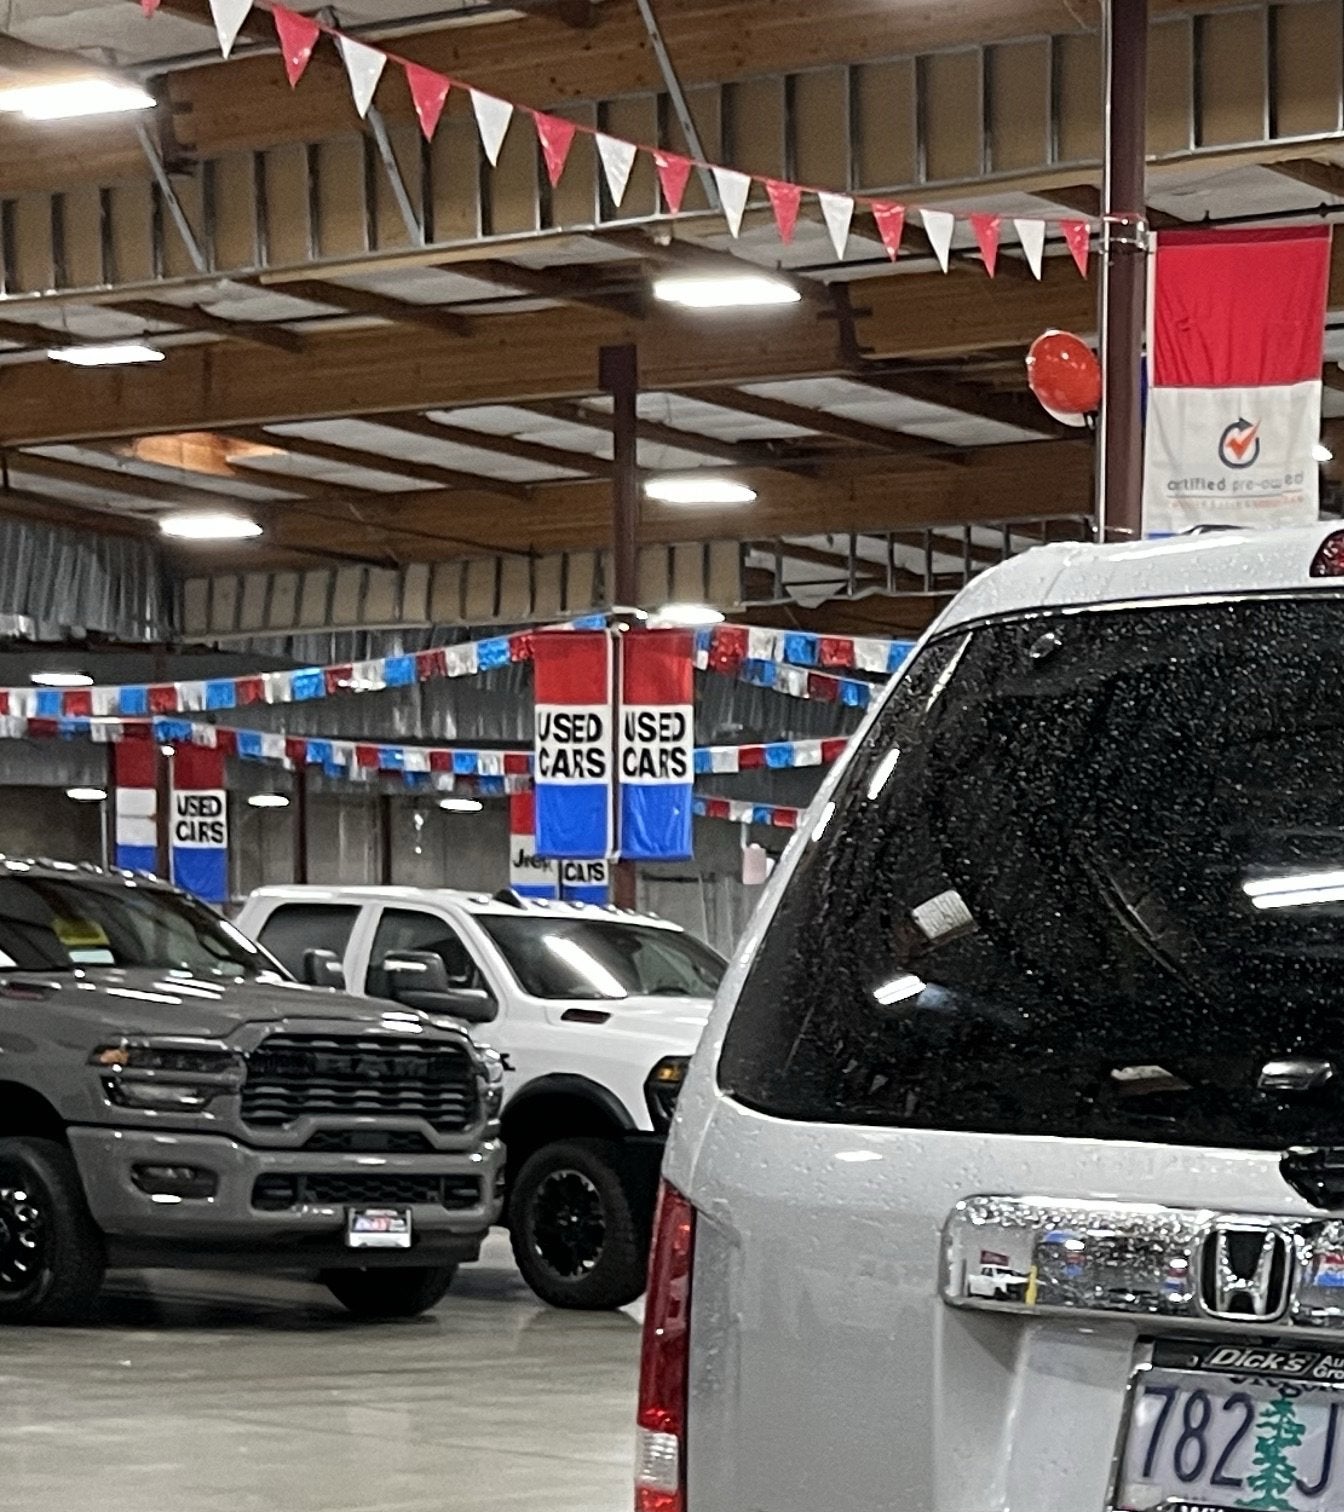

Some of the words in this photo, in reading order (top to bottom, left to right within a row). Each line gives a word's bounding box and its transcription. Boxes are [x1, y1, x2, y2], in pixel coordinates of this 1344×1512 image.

[538, 712, 603, 743] USED
[624, 711, 686, 743] USED
[538, 747, 606, 778] CARS
[622, 746, 687, 778] CARS
[177, 795, 222, 817] USED
[1211, 1349, 1307, 1372] Dick's
[1142, 1386, 1255, 1488] 782
